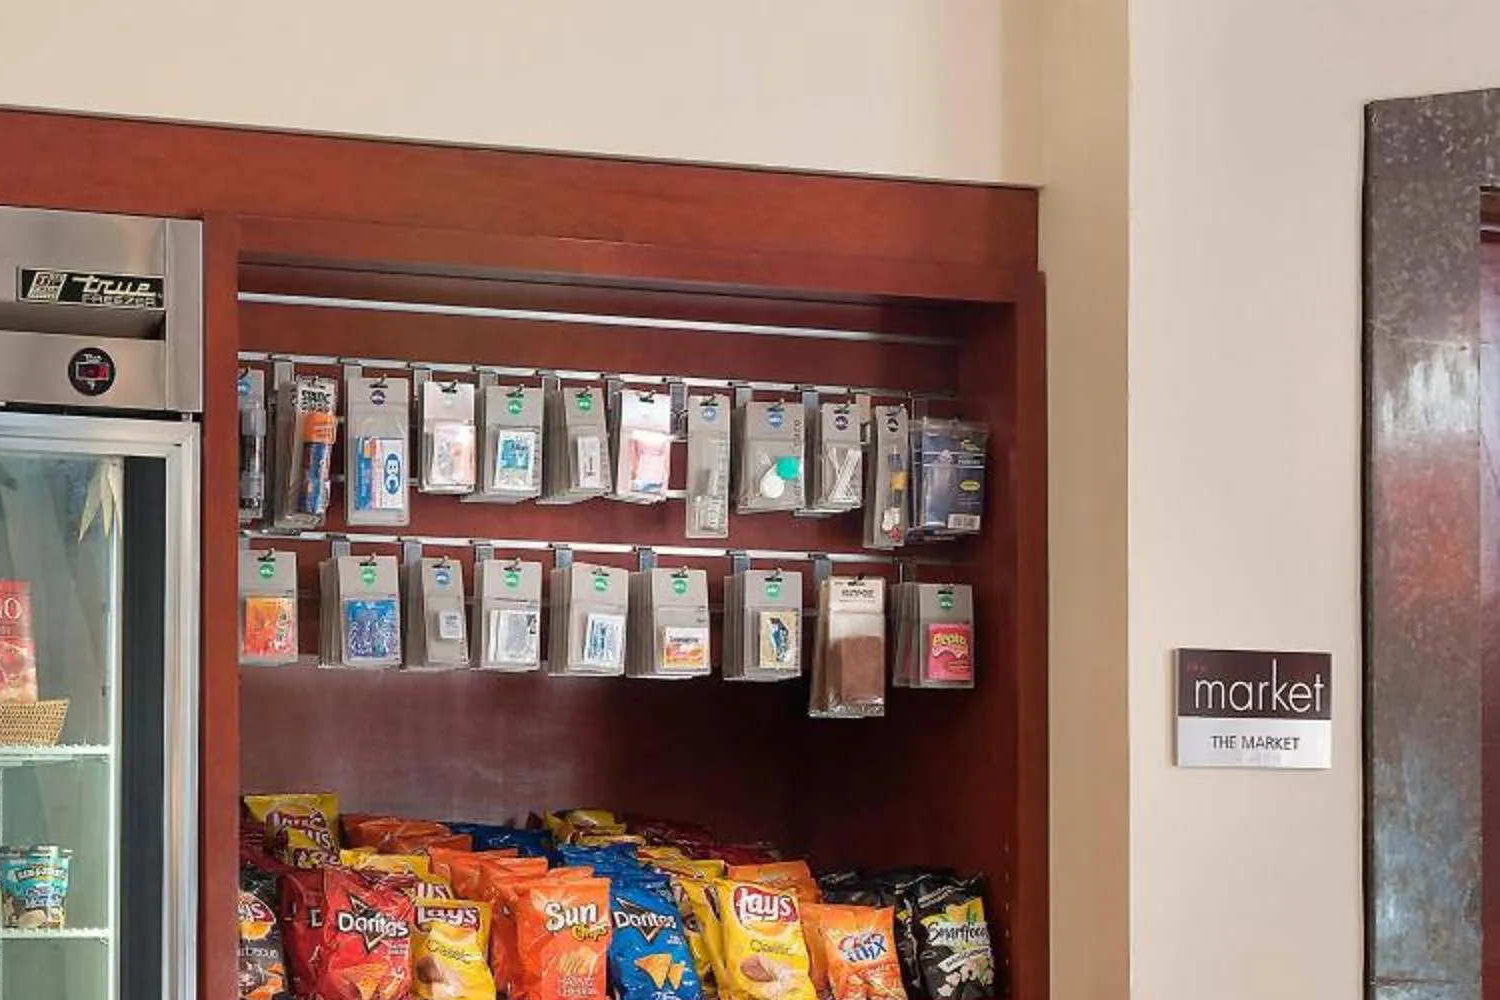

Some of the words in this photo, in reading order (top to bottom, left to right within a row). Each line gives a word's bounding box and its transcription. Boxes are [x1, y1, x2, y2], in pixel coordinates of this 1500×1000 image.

[1195, 658, 1325, 713] market
[1210, 735, 1237, 750] THE
[1241, 736, 1301, 751] MARKET
[337, 909, 410, 938] Doritos
[544, 902, 598, 932] Sun
[612, 911, 677, 930] Doritos
